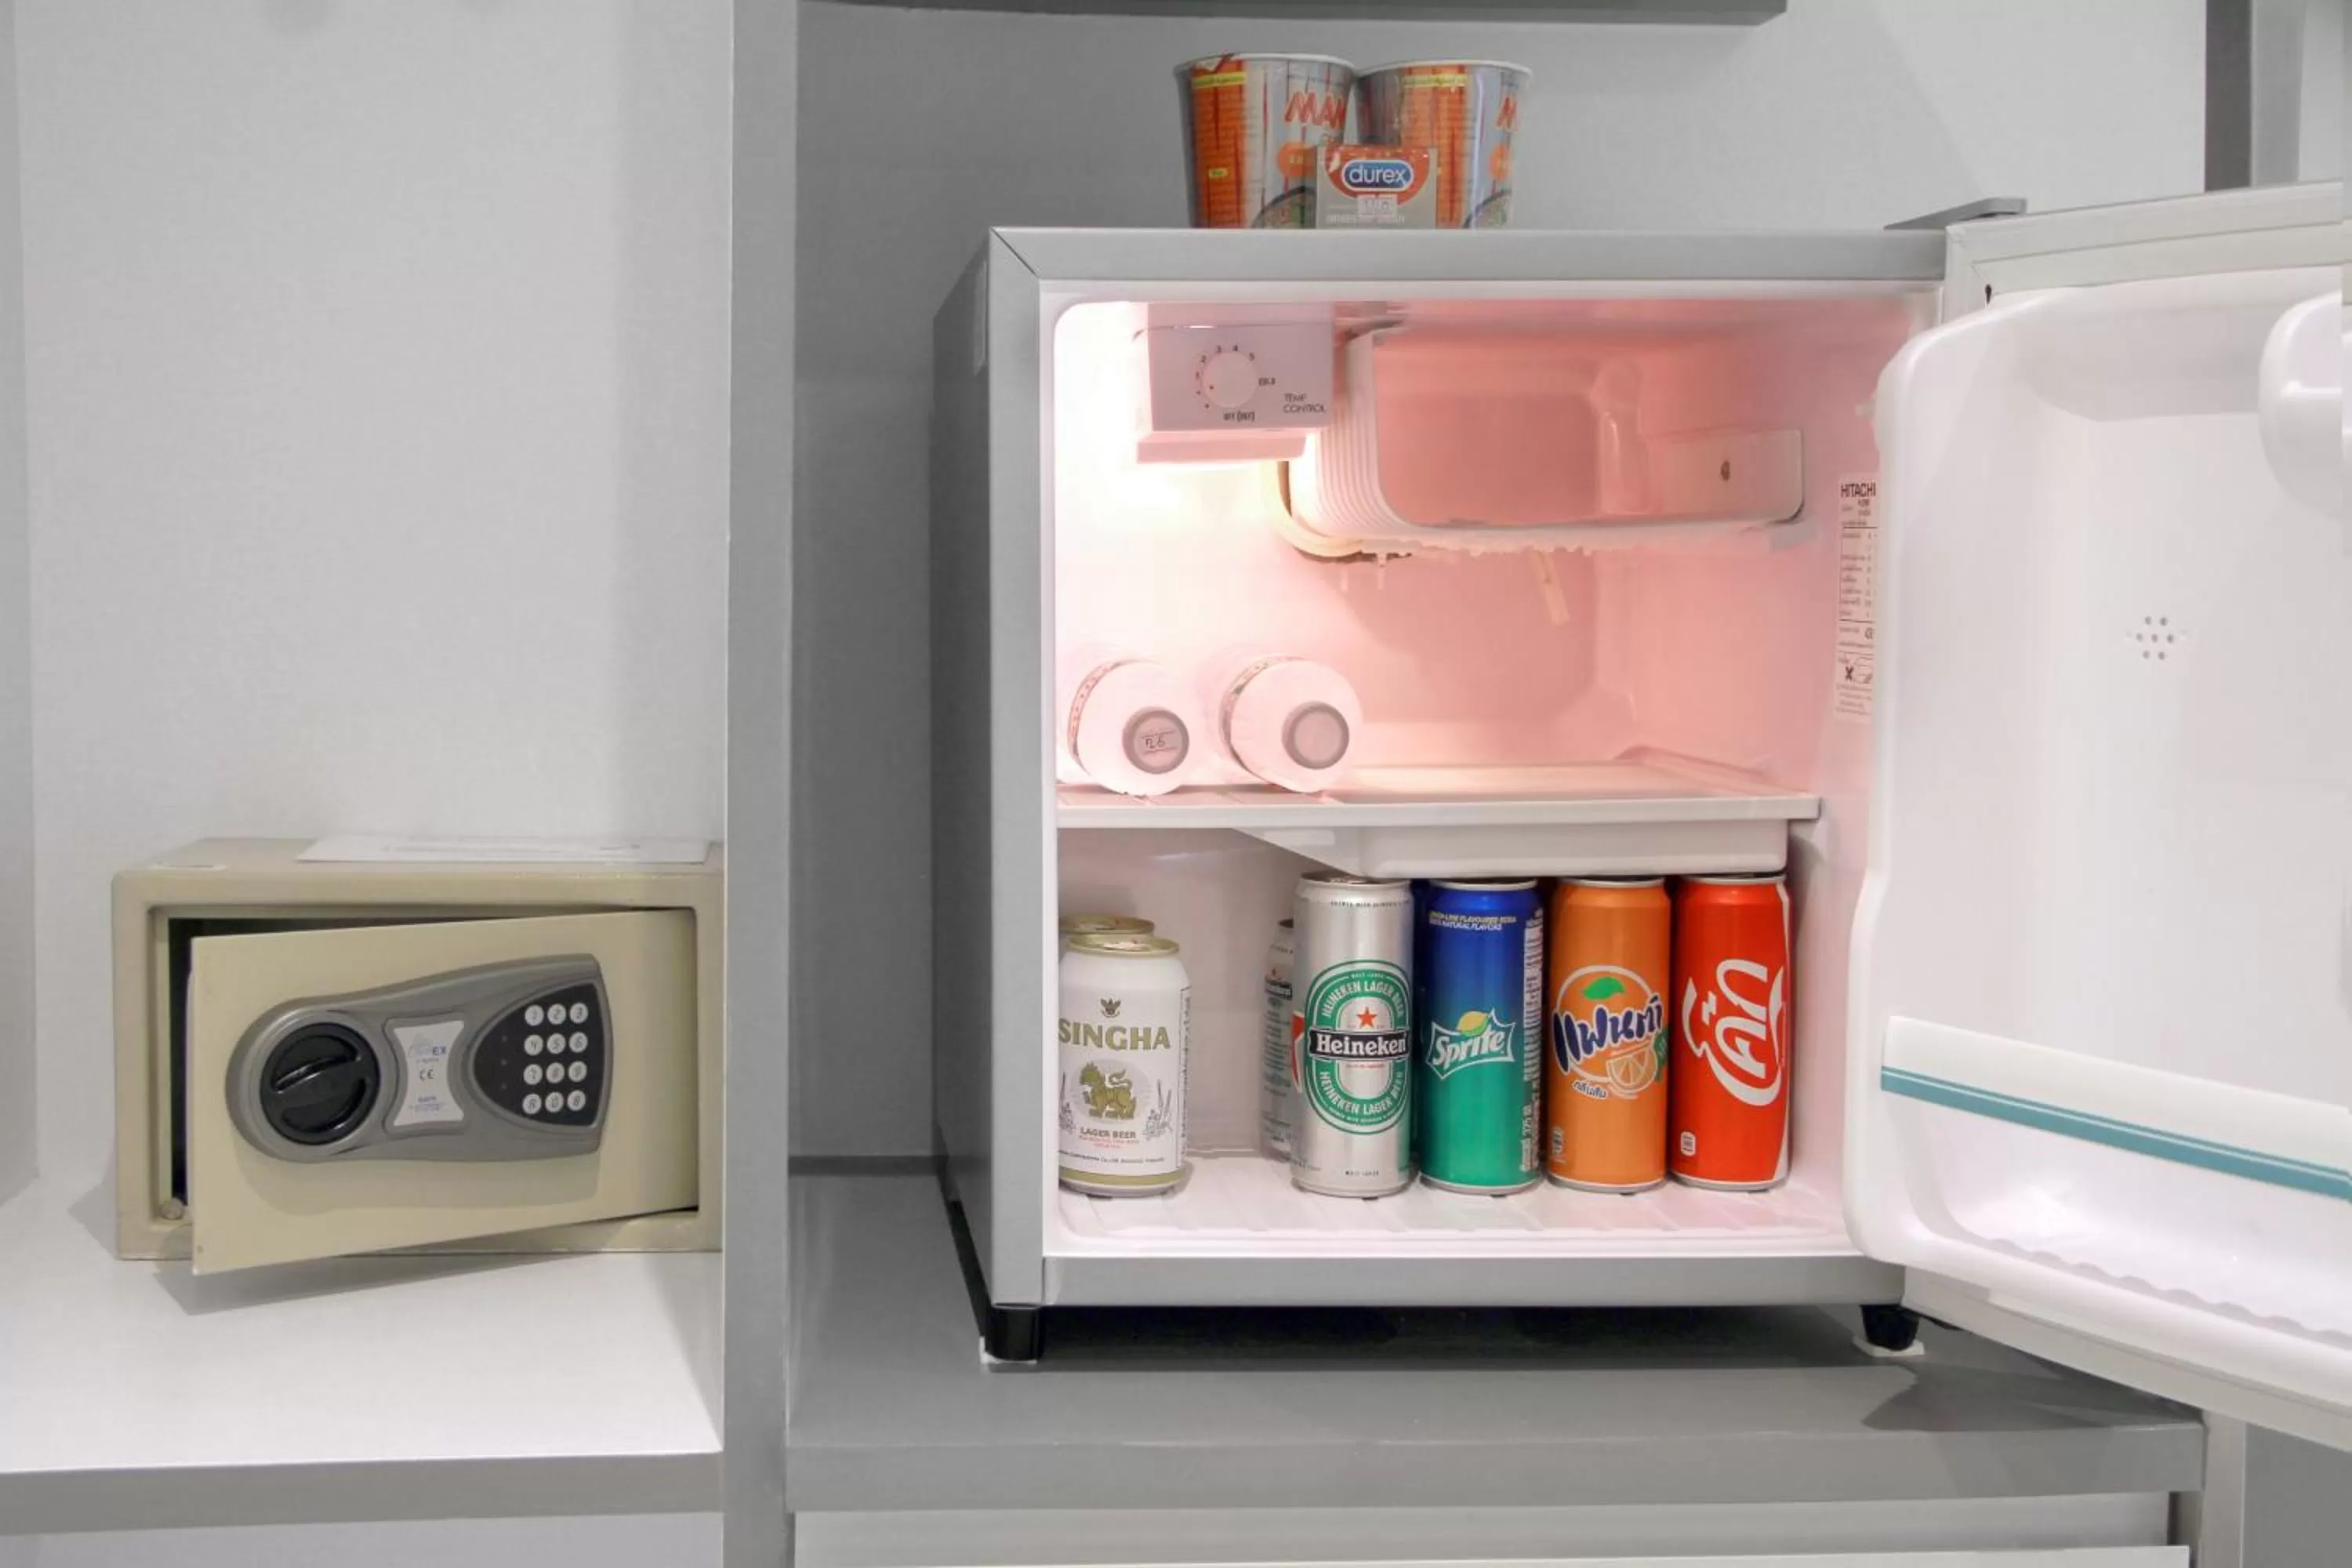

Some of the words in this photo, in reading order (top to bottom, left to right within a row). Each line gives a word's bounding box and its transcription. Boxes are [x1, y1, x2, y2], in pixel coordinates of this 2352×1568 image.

[1348, 163, 1407, 184] durex
[1283, 403, 1326, 414] CONTROL
[1840, 482, 1876, 498] HITACHI
[1058, 1018, 1171, 1051] SINGHA
[1316, 1033, 1406, 1056] Heineken
[1433, 1026, 1505, 1069] Sprite
[1080, 1127, 1110, 1137] LAGER
